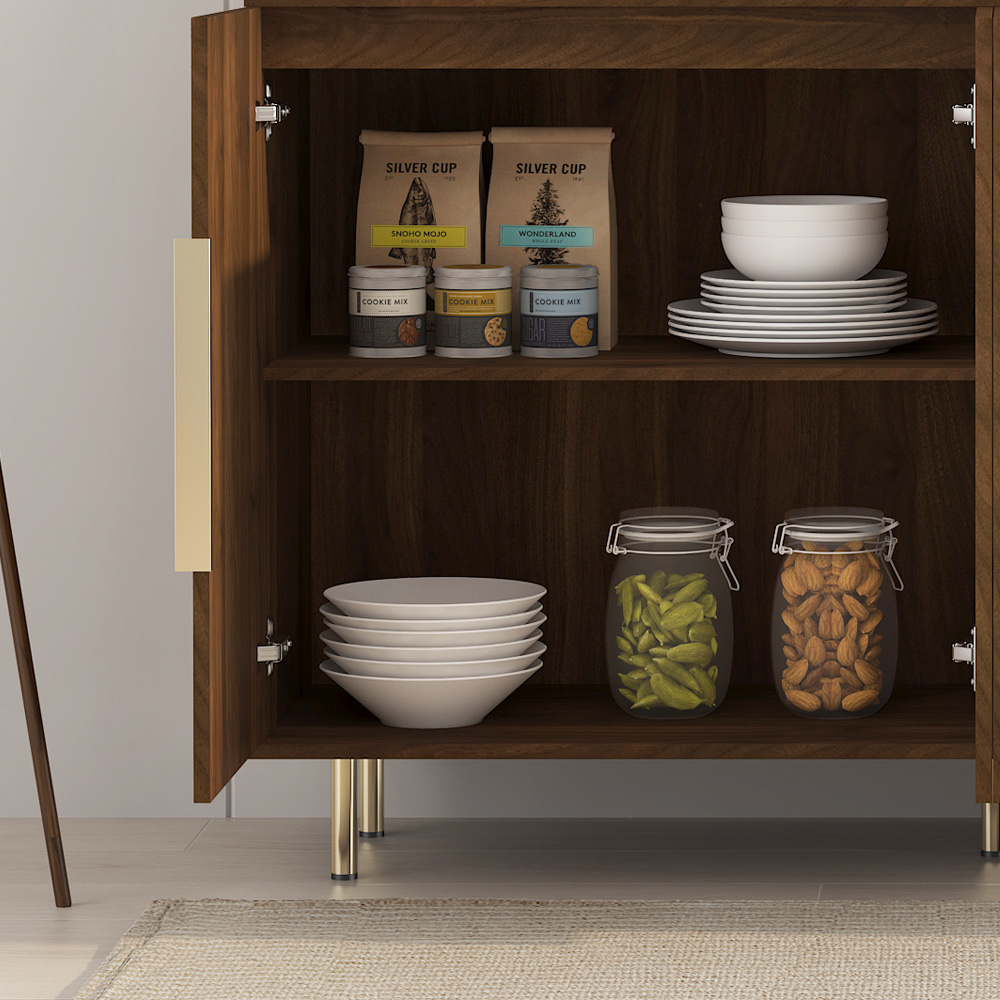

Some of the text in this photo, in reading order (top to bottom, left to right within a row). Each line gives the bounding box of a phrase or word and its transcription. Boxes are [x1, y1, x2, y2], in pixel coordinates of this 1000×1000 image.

[386, 162, 457, 173] SILVER CUP
[516, 162, 586, 174] SILVER CUP
[391, 230, 447, 238] SNOHO MOJO
[519, 230, 577, 238] WONDERLAND
[521, 317, 546, 342] UGAR
